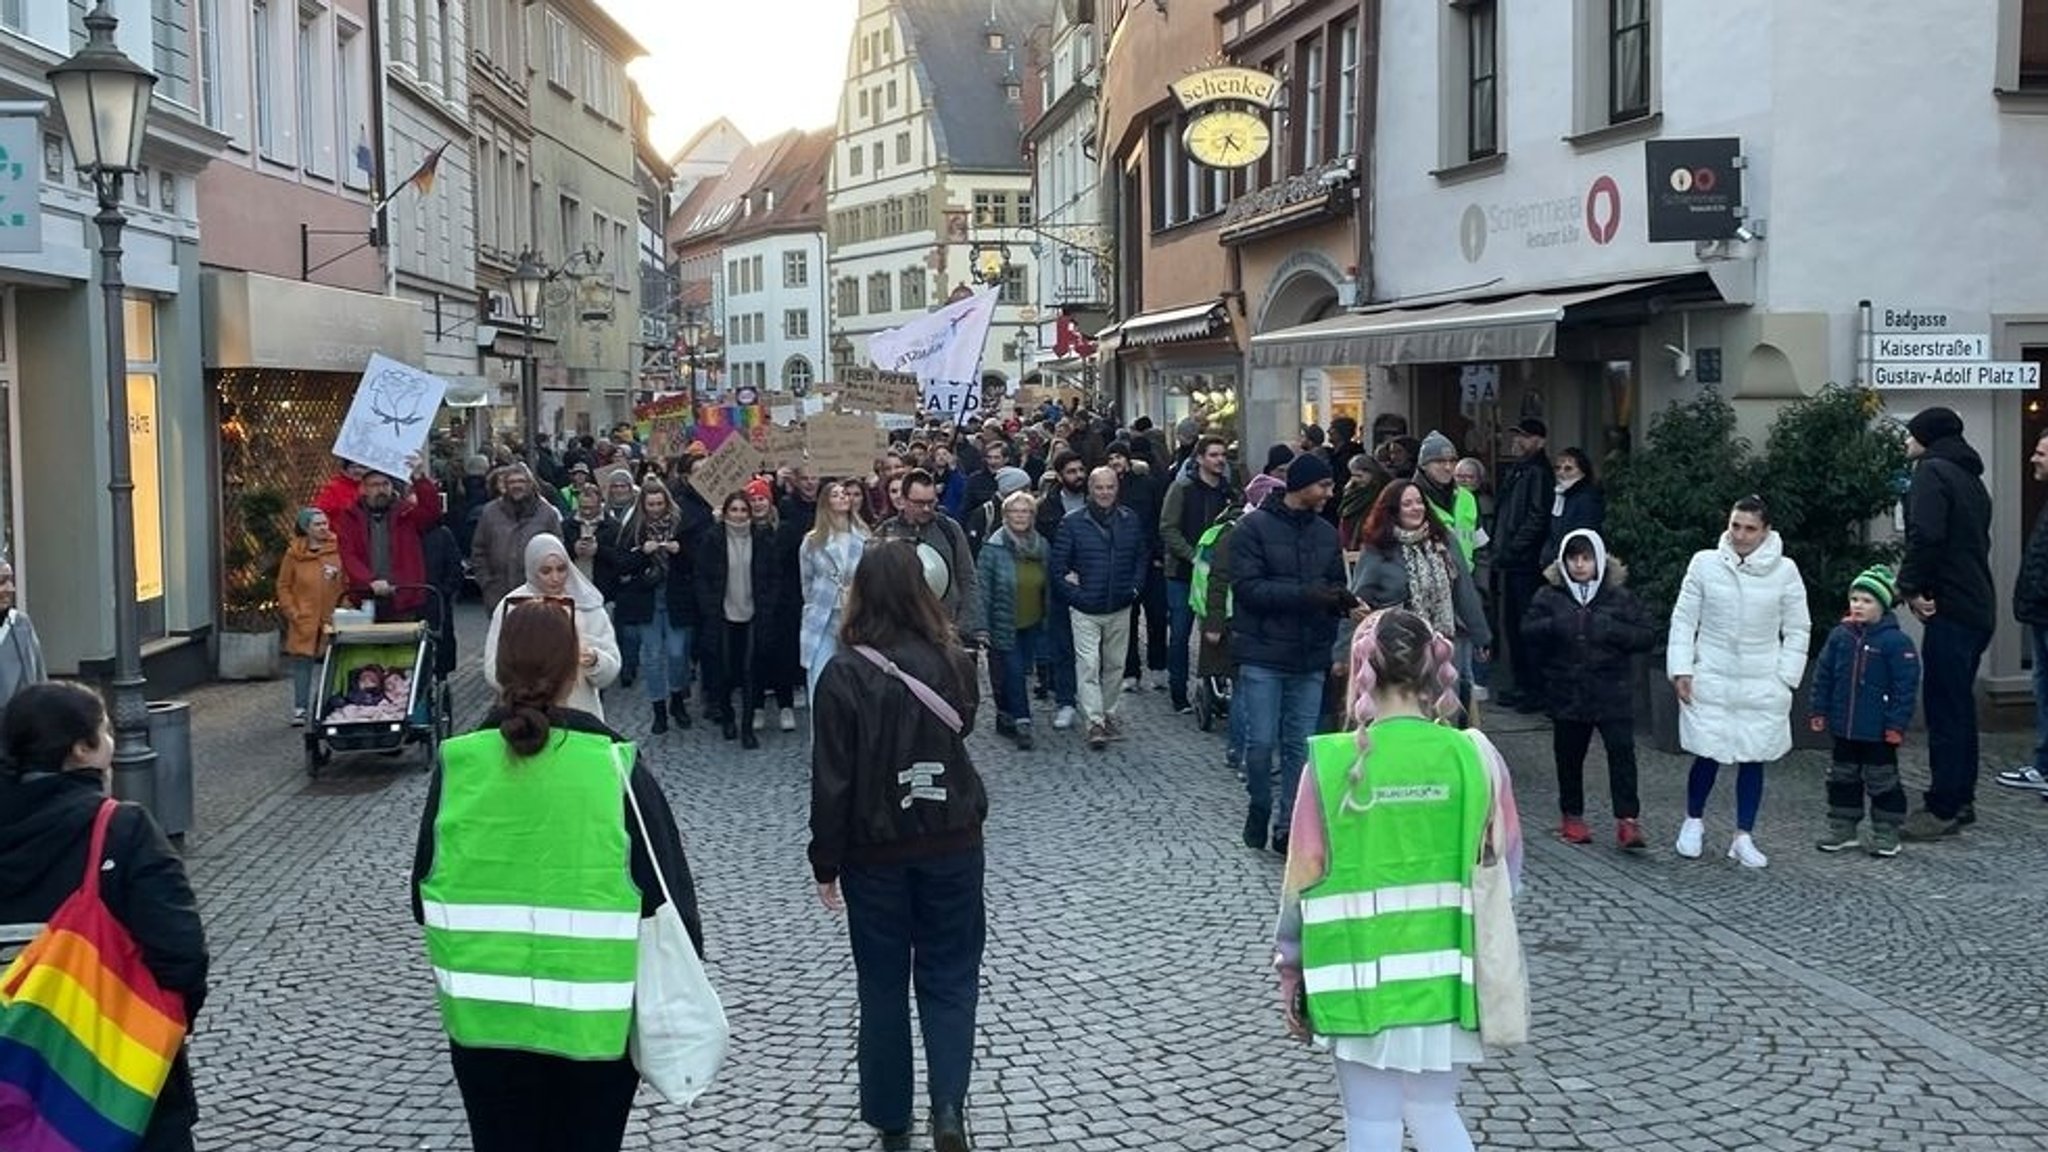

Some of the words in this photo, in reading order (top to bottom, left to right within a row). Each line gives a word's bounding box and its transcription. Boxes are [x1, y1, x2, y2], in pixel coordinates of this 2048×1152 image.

[1183, 76, 1274, 103] schenkel
[1885, 309, 1947, 331] Badgasse
[1880, 339, 1972, 356] Kaiserstraße
[1976, 339, 1982, 356] 1
[1875, 367, 1972, 385] Gustav-Adolf
[1978, 367, 2014, 385] Platz
